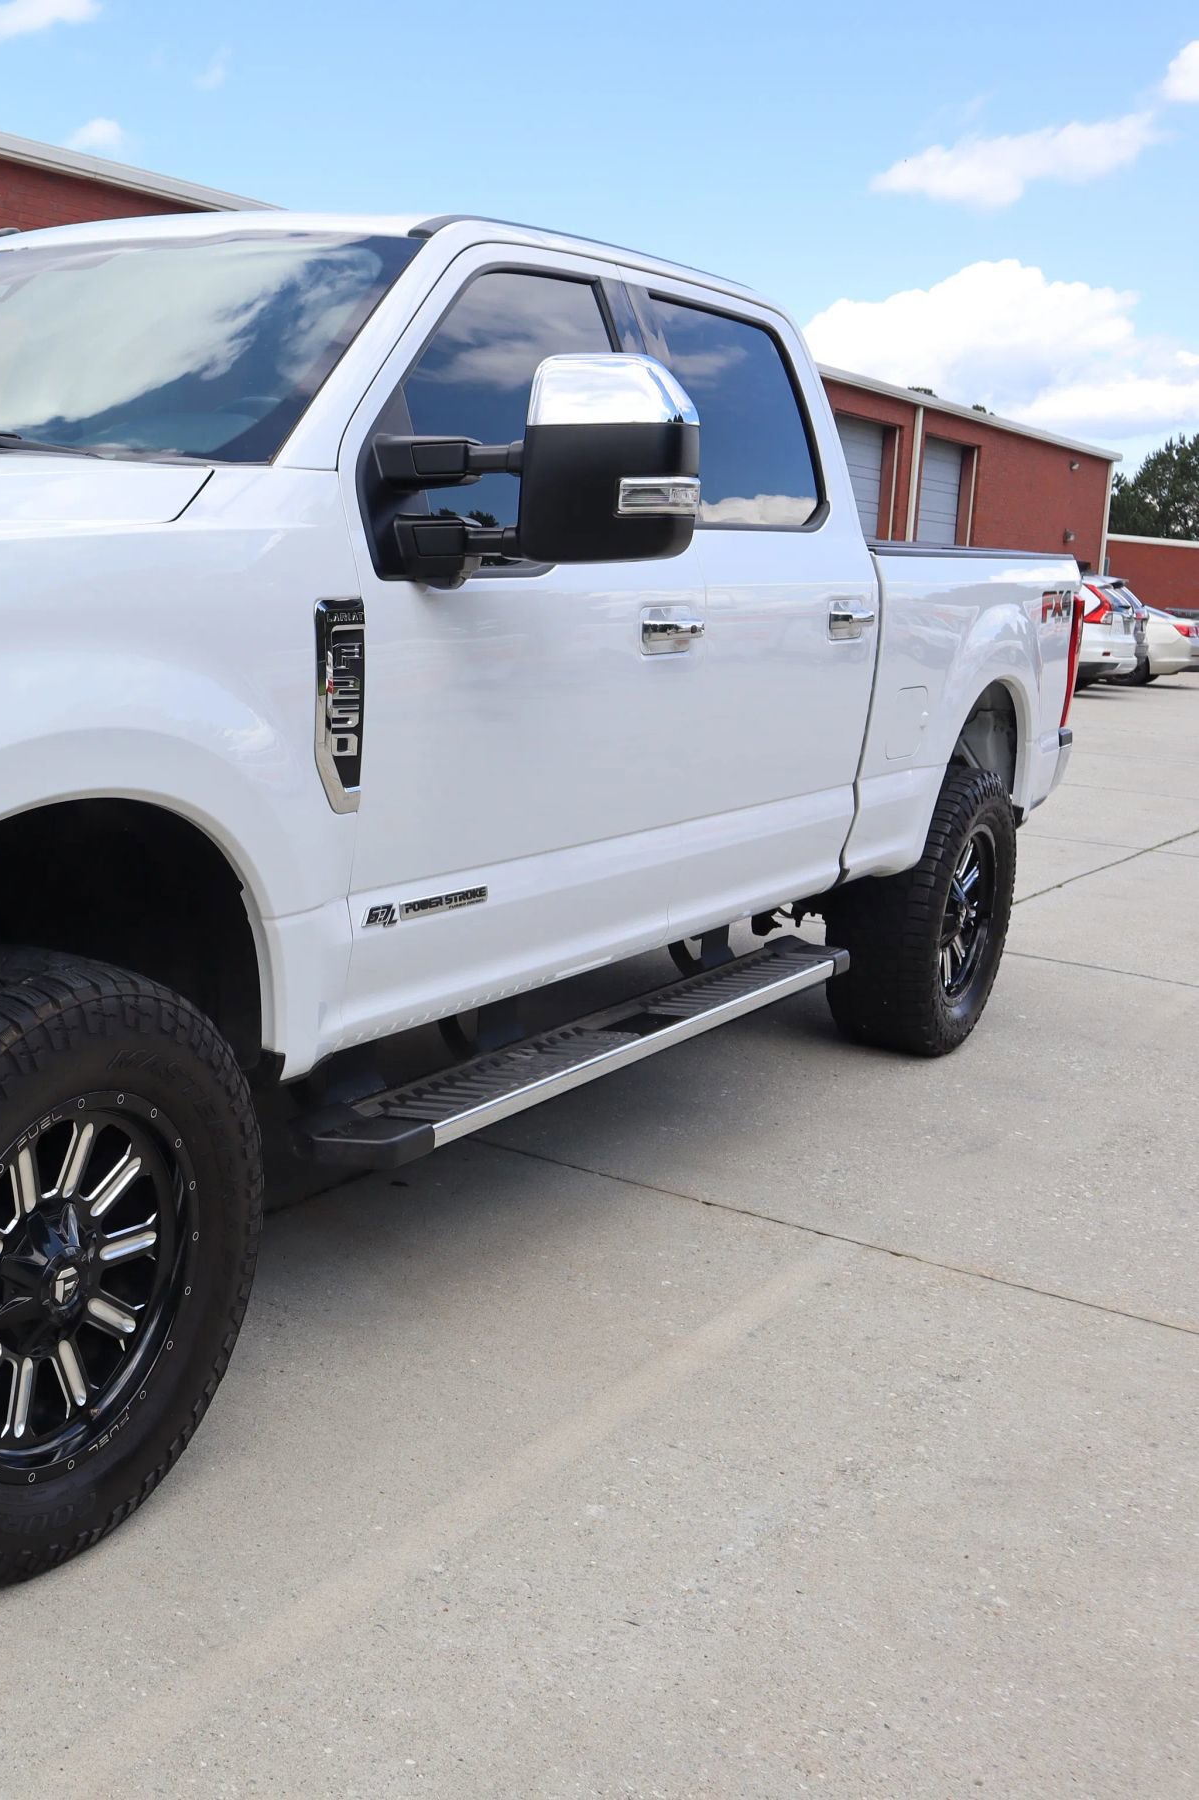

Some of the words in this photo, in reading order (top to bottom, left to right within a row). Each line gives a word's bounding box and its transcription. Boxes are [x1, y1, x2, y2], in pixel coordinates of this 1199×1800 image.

[326, 611, 364, 623] LARIAT
[1042, 590, 1072, 623] FX4
[404, 895, 444, 914] POWER
[444, 886, 487, 905] STROKE
[16, 1112, 63, 1152] FUEL
[88, 1411, 130, 1452] FUEL
